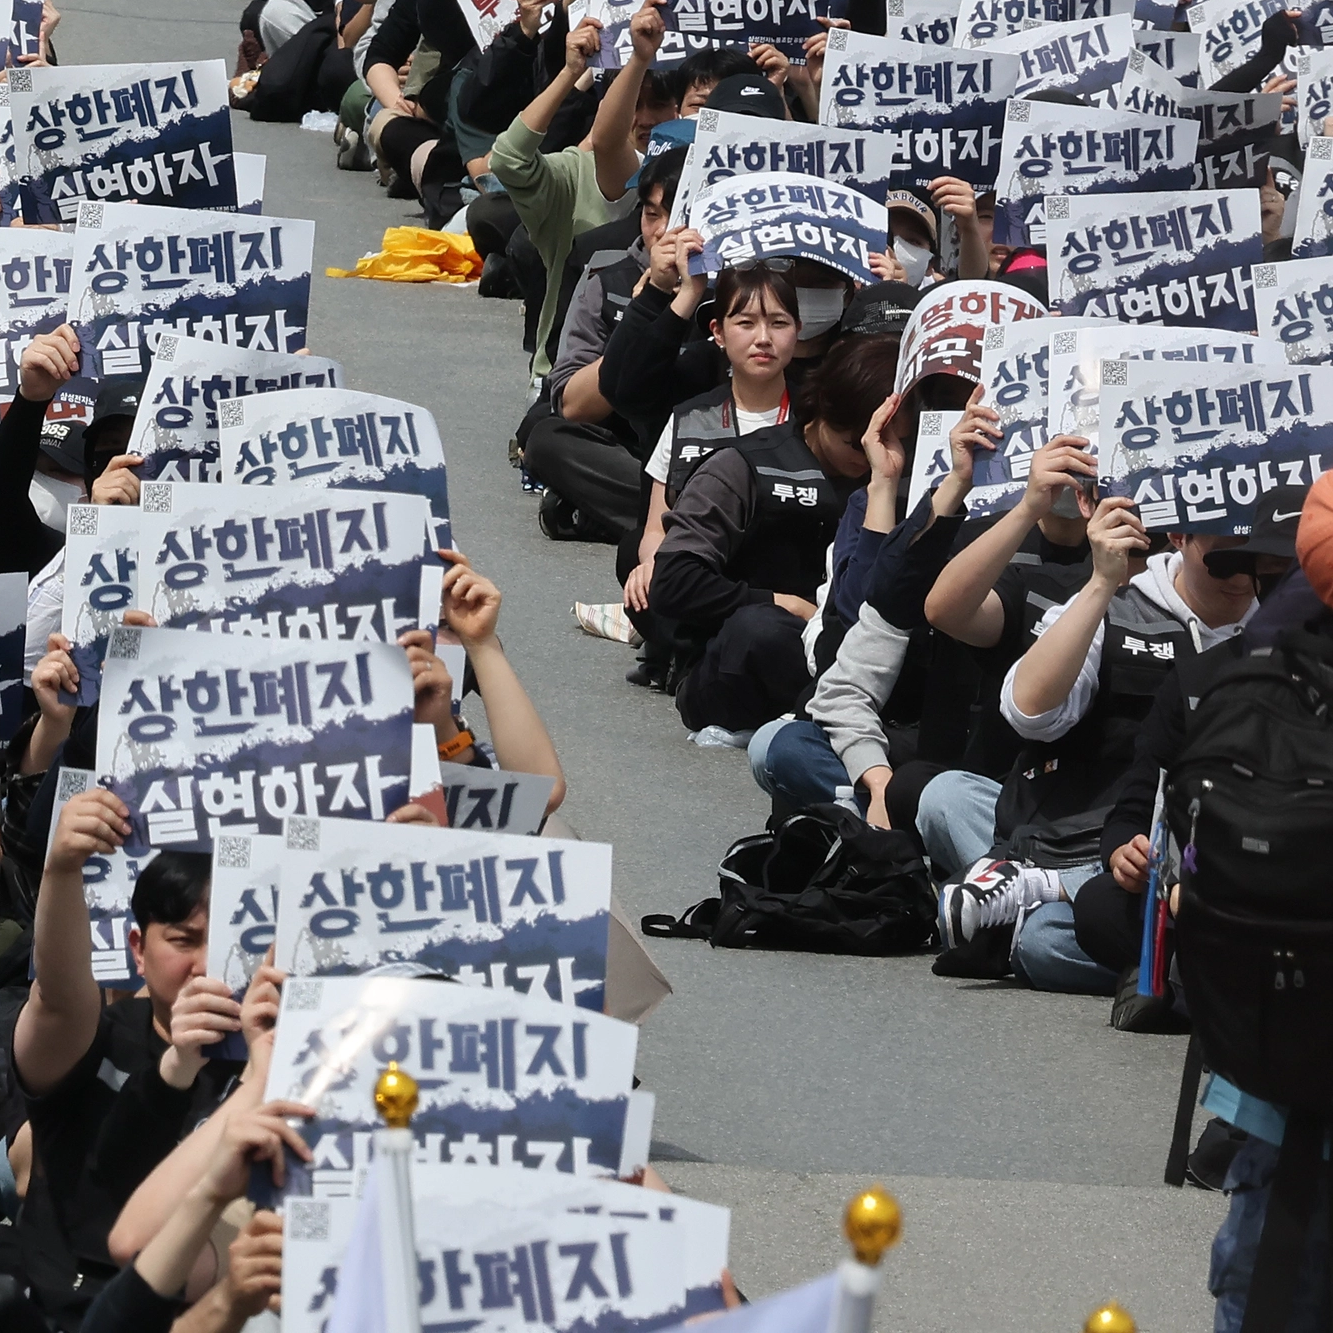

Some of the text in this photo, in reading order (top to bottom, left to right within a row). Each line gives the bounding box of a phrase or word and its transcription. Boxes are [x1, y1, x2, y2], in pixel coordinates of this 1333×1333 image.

[27, 70, 200, 151] 상한폐지
[833, 58, 993, 108] 상한폐지
[50, 142, 231, 222] 실현하자
[1015, 124, 1176, 179] 상한폐지
[703, 183, 864, 225] 상한폐지
[885, 190, 928, 214] ARBOUR
[1061, 196, 1233, 273] 상한폐지
[85, 225, 283, 295] 상한폐지
[717, 221, 871, 262] 실현하자
[234, 411, 423, 484] 상한폐지
[1117, 372, 1315, 450] 상한폐지
[771, 483, 818, 506] 투쟁
[156, 502, 389, 588] 상한폐지
[1121, 634, 1175, 660] 투쟁
[119, 651, 373, 743] 상한폐지
[138, 754, 412, 846] 실현하자
[301, 850, 567, 938] 상한폐지
